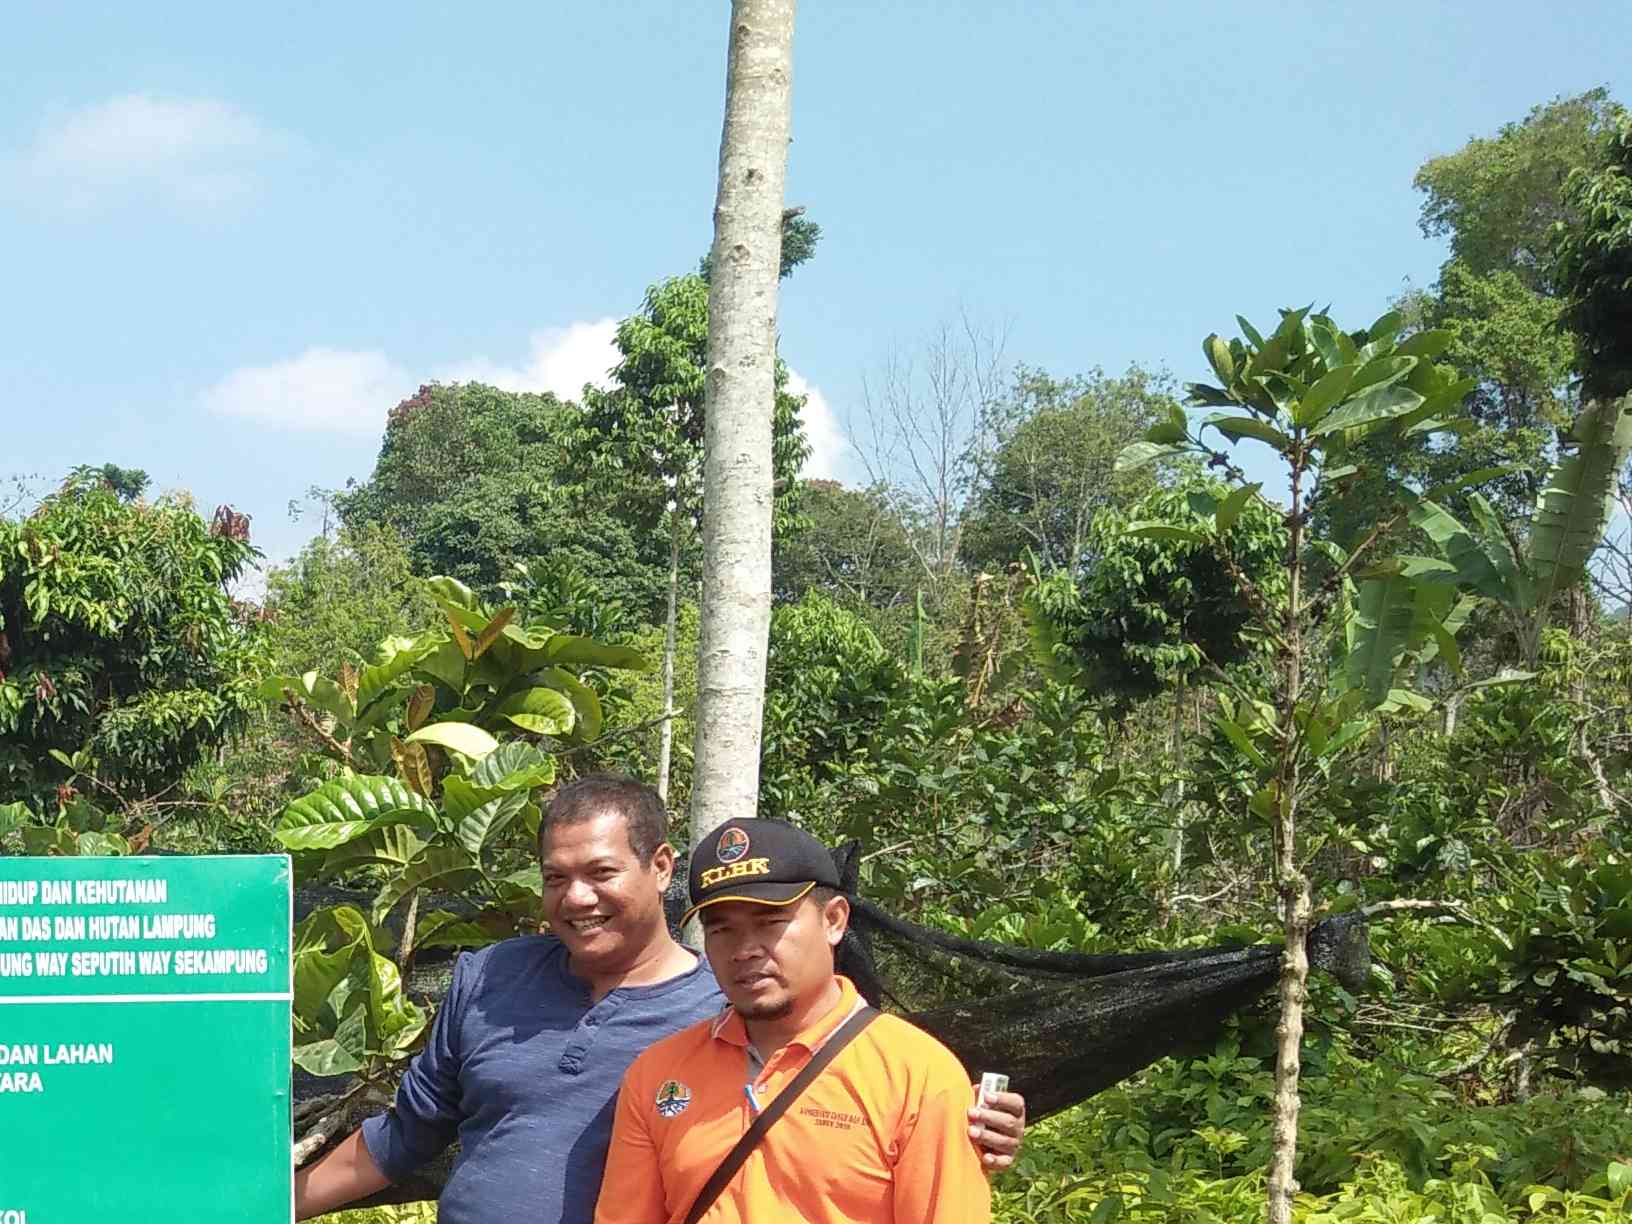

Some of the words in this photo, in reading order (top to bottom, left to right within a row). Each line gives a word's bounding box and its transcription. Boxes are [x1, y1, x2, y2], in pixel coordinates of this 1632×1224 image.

[700, 858, 770, 888] KLHK
[40, 879, 73, 905] DAN
[75, 879, 168, 905] KEHUTANAN
[21, 916, 52, 941] DAS
[54, 916, 86, 941] DAN
[88, 915, 141, 940] HUTAN
[142, 913, 216, 940] LAMPUNG
[35, 952, 69, 977] WAY
[71, 951, 136, 977] SEPUTIH
[137, 950, 172, 975] WAY
[174, 949, 268, 975] SEKAMPUNG
[43, 1043, 113, 1065] LAHAN
